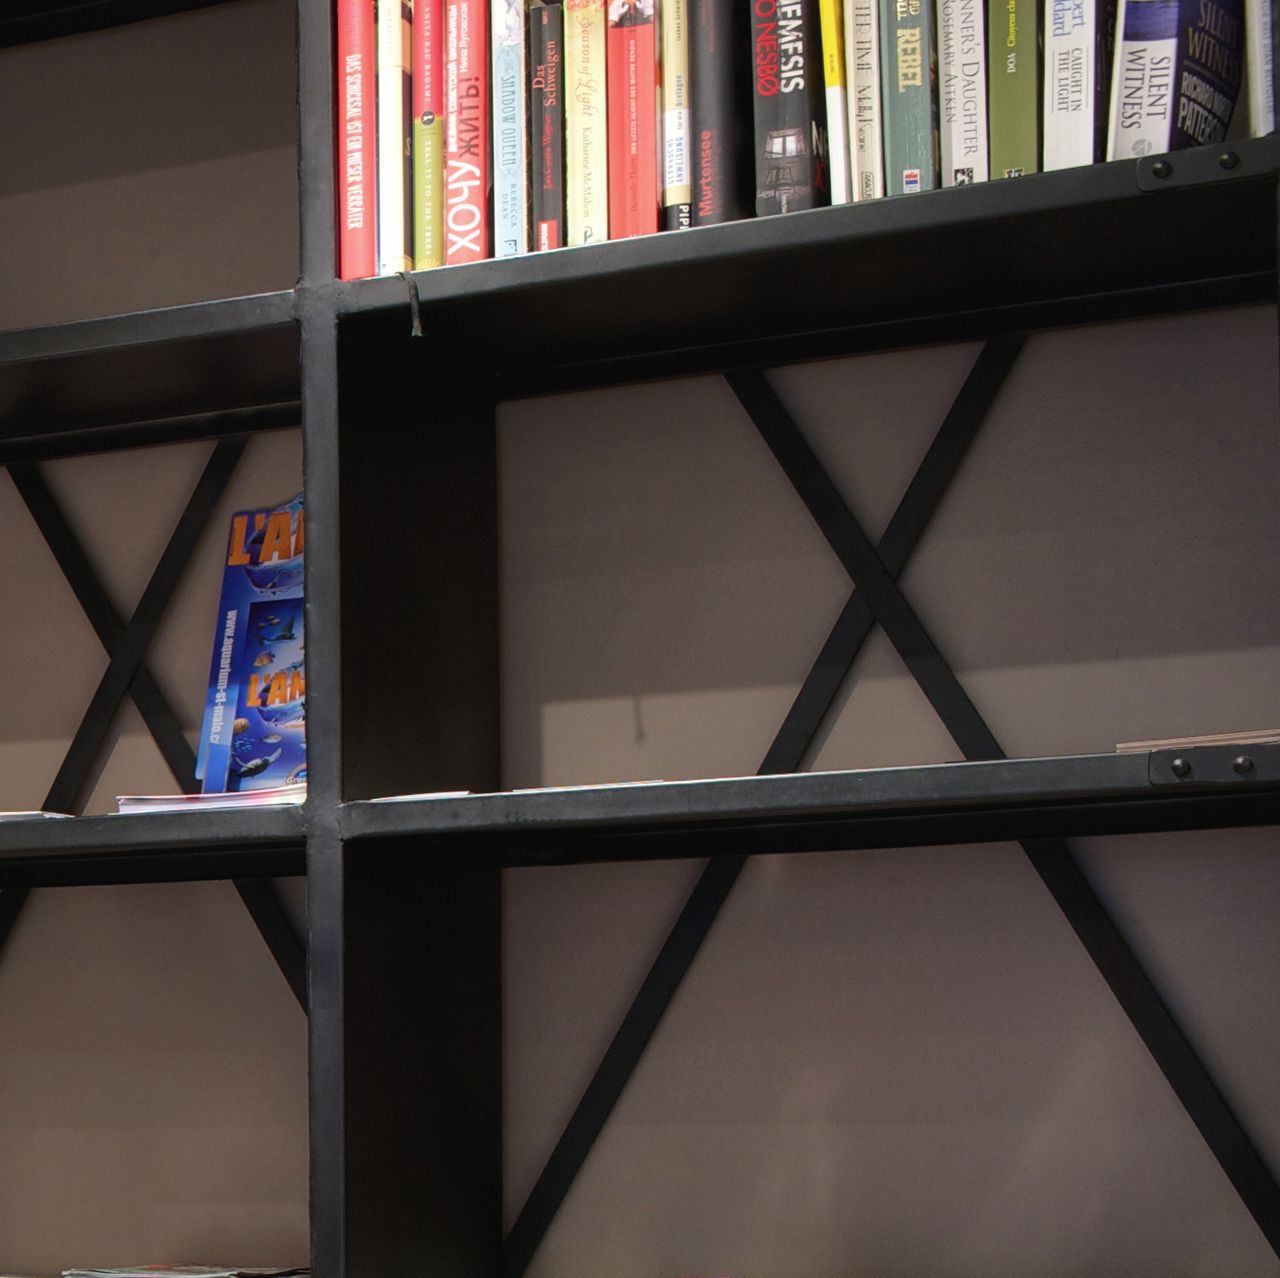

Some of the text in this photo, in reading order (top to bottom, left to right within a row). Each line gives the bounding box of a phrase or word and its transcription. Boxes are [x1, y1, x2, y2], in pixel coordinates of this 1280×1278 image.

[423, 7, 432, 103] ANITA RAU BADAMI
[532, 65, 546, 89] Das
[543, 40, 559, 107] Schweigen
[754, 0, 780, 97] O NESBØ
[855, 39, 873, 76] TIME
[897, 27, 922, 93] REBEL
[1007, 52, 1016, 73] DOA
[1071, 48, 1082, 112] CAUGHT IN
[448, 61, 458, 112] СОВЕТСКОЙ
[501, 75, 516, 124] SHADOW
[944, 72, 958, 124] AITKEN
[961, 61, 981, 157] DAUGHTER
[1057, 51, 1069, 113] THE LIGHT
[1121, 47, 1147, 130] WITNESS
[1145, 55, 1171, 121] SILENT
[347, 55, 364, 230] DAS SCHICKSAL IST EIN MIESER VERRÄTER
[448, 113, 457, 153] ДНЕВНИК
[458, 76, 480, 158] ЖИТЬ!
[502, 128, 517, 167] QUEEN
[582, 127, 593, 171] Katharine
[674, 136, 684, 184] ANWEISUNG
[698, 130, 713, 217] Murtensee
[423, 139, 433, 256] TELL IT TO THE TREES
[448, 160, 481, 255] ХОЧУ
